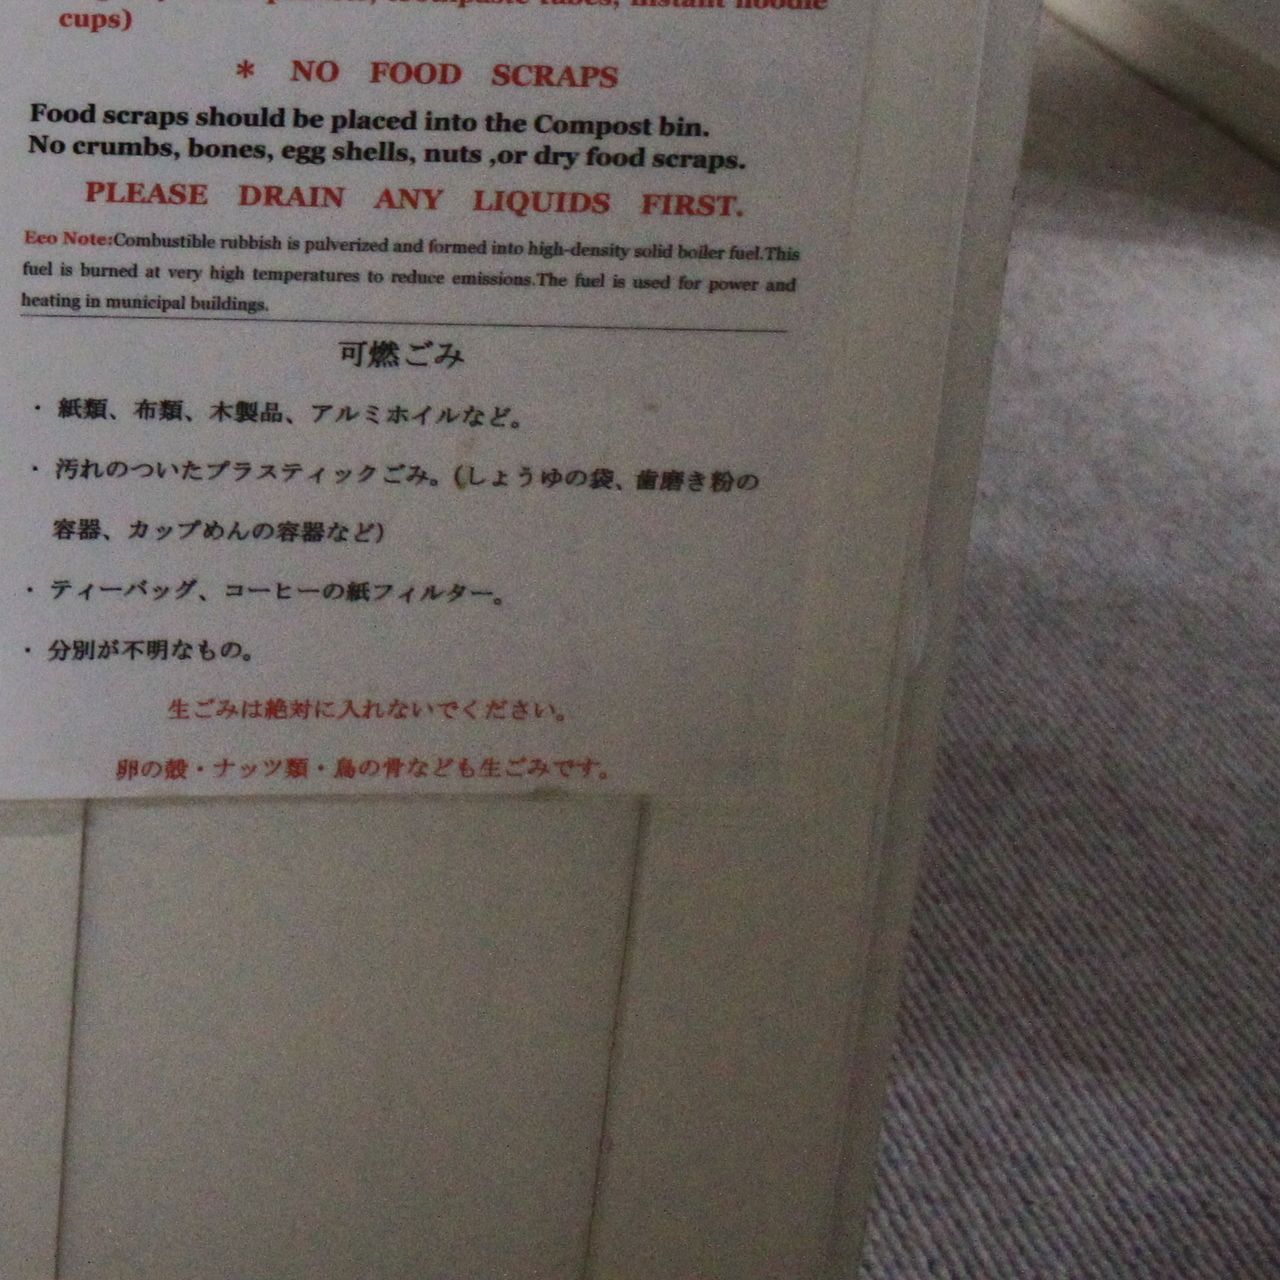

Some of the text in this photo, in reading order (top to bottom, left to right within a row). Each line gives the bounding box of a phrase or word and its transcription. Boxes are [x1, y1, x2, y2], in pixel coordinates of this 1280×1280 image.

[289, 59, 619, 89] NO FOOD SCRAPS
[29, 101, 710, 141] Food scraps should be placed into the Compost bin.
[85, 180, 744, 218] PLEASE DRAIN ANY LIQUIDS FIRST.
[20, 291, 269, 316] heating in municipal buildings.
[338, 339, 465, 369] 可燃ごみ
[50, 577, 503, 607] ティーバッグ、コーヒーの紙フィルター。
[47, 638, 252, 663] 分別が不明なもの。
[167, 697, 565, 723] 生ごみは絶対に入れないでください。
